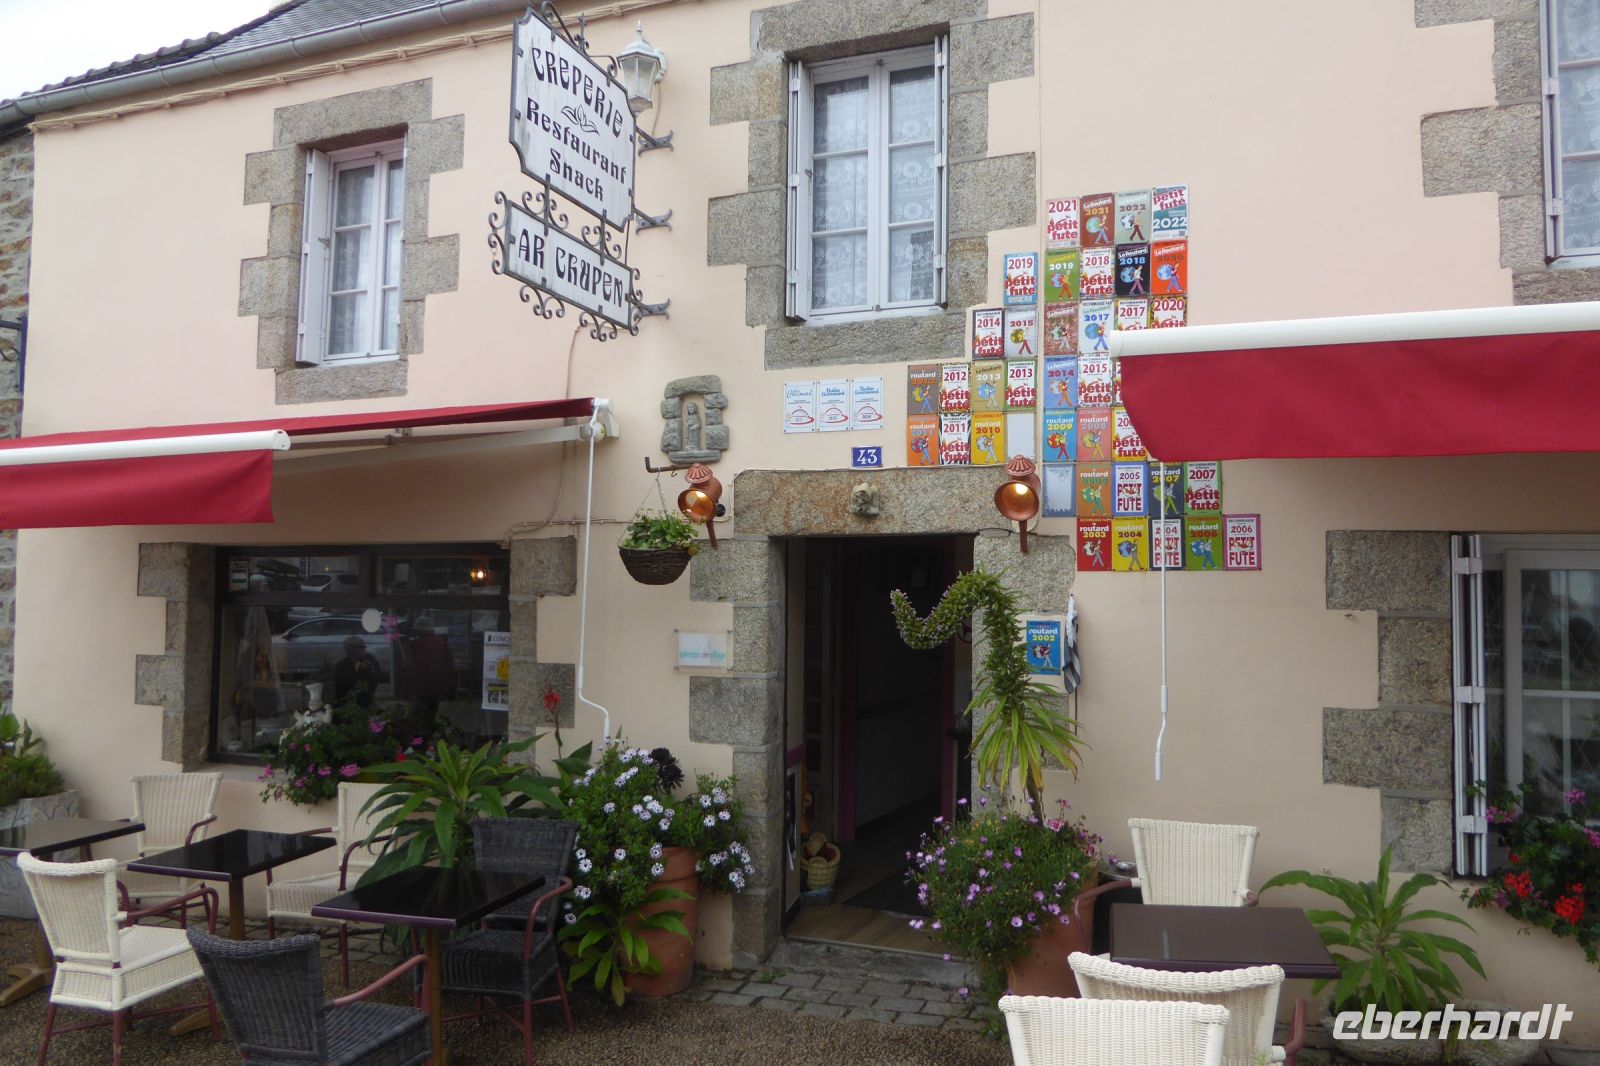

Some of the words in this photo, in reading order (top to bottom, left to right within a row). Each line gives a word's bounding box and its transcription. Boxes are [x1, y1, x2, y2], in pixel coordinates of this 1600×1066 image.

[532, 48, 623, 138] CREPERIE
[526, 97, 626, 184] Restaurant
[550, 148, 603, 201] Snack
[1153, 188, 1184, 205] petit
[1049, 200, 1077, 213] 2021
[1086, 207, 1109, 215] 2021
[1120, 204, 1146, 212] 2022
[1047, 219, 1078, 234] petit
[1153, 217, 1187, 229] 2022
[518, 228, 545, 269] AR
[1009, 258, 1033, 270] 2019
[1049, 262, 1074, 270] 2019
[1085, 256, 1110, 266] 2018
[1120, 257, 1145, 265] 2018
[1004, 275, 1036, 289] petit
[1080, 274, 1113, 288] petit
[1154, 299, 1185, 311] 2020
[1084, 313, 1110, 321] 2017
[1120, 307, 1146, 317] 2017
[977, 318, 1000, 328] 2014
[1010, 368, 1033, 378] 2013
[1083, 363, 1107, 373] 2015
[944, 371, 967, 381] 2012
[976, 373, 1000, 381] 2013
[1005, 387, 1037, 400] petit
[1079, 382, 1111, 395] petit
[940, 390, 970, 403] petit
[943, 423, 966, 433] 2011
[940, 442, 970, 454] petit
[857, 449, 878, 465] 43
[1119, 472, 1140, 480] 2005
[1152, 475, 1179, 483] 207
[1189, 469, 1216, 480] 2007
[1185, 489, 1220, 502] petit
[1155, 526, 1178, 535] 204
[1189, 523, 1218, 531] routard
[1231, 525, 1253, 533] 2006
